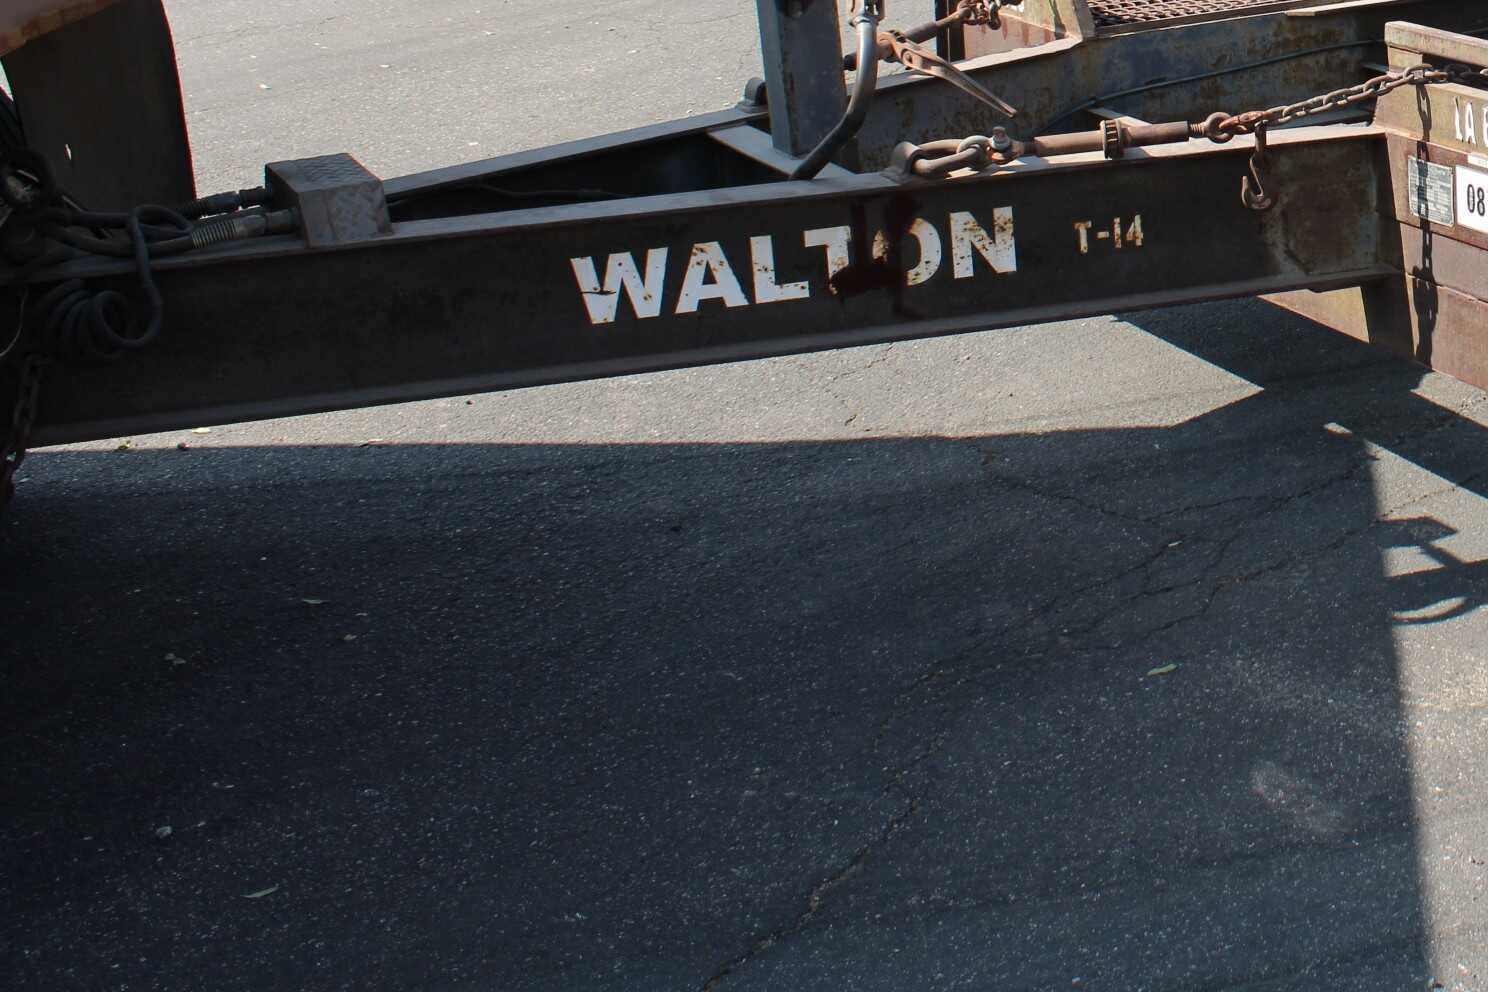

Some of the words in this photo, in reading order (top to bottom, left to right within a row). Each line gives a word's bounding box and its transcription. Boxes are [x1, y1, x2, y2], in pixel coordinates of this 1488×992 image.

[1466, 183, 1486, 217] 08
[1073, 214, 1144, 254] T-14
[570, 206, 1018, 325] WALTON
